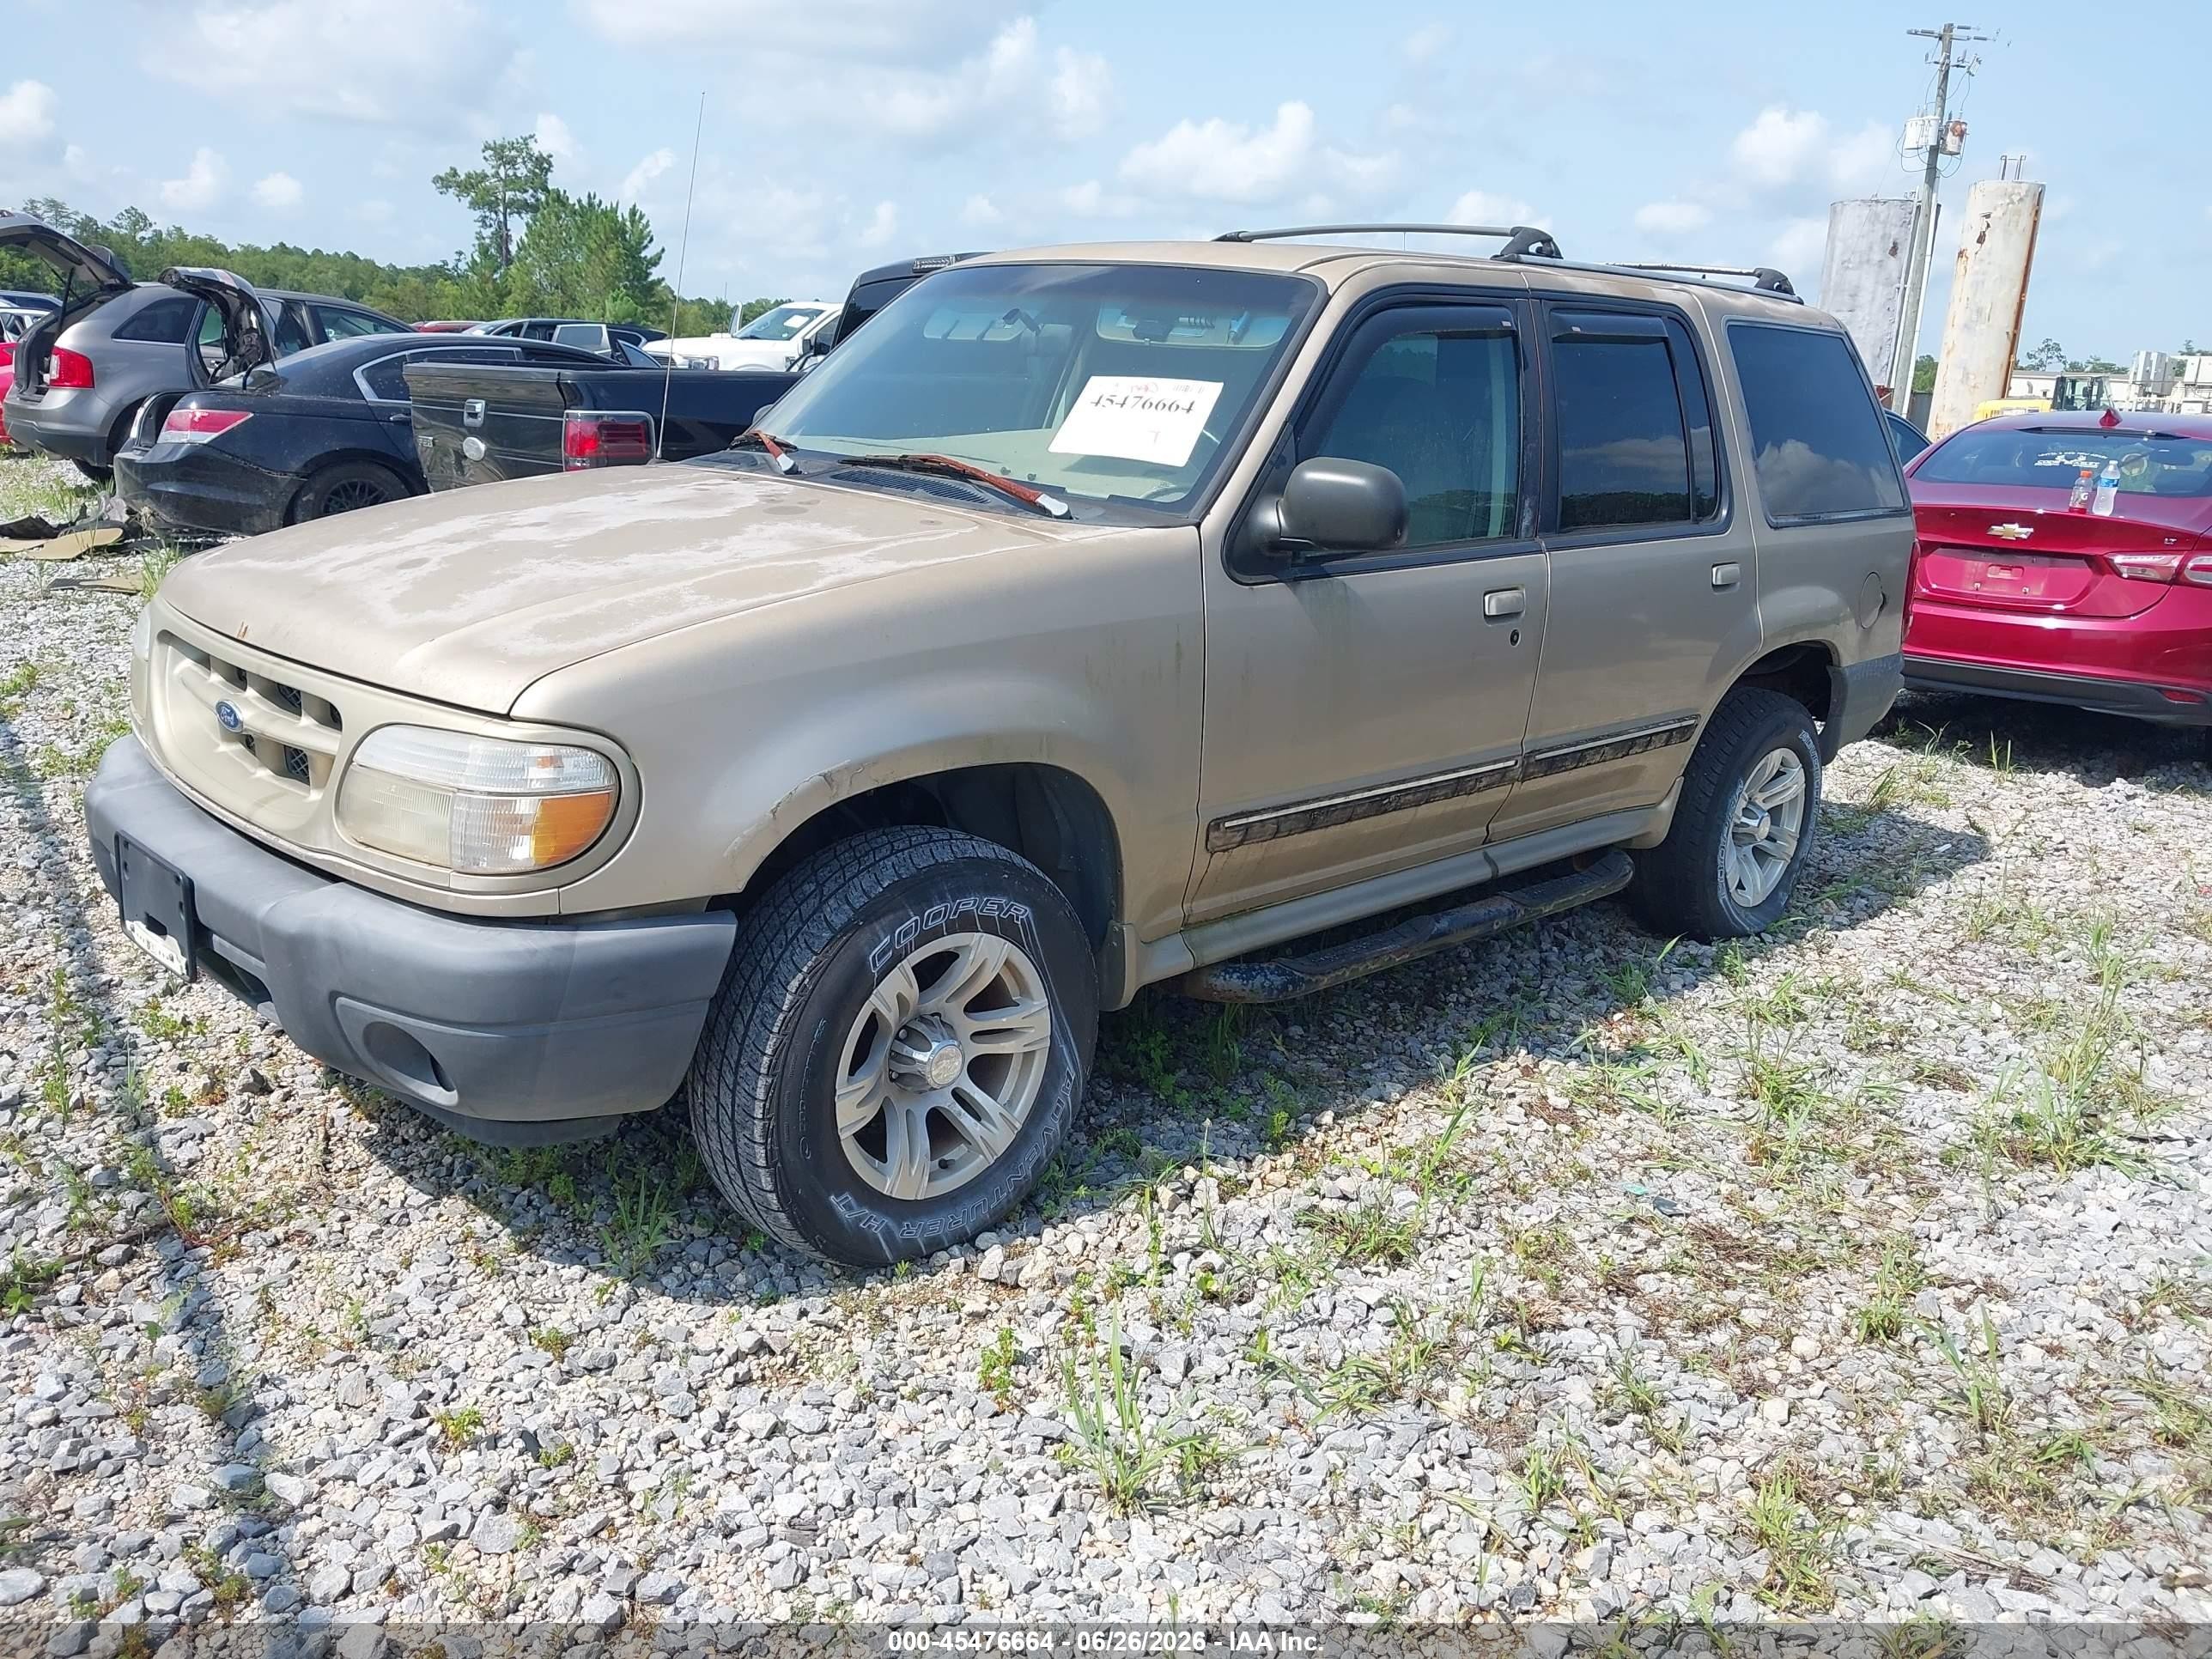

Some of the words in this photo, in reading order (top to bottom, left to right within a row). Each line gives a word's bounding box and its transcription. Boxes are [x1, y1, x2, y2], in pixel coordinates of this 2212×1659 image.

[1090, 394, 1195, 414] 45476664
[869, 897, 1030, 973] COOPER
[899, 1066, 1076, 1238] ADVENTURER
[830, 1193, 888, 1234] H/T
